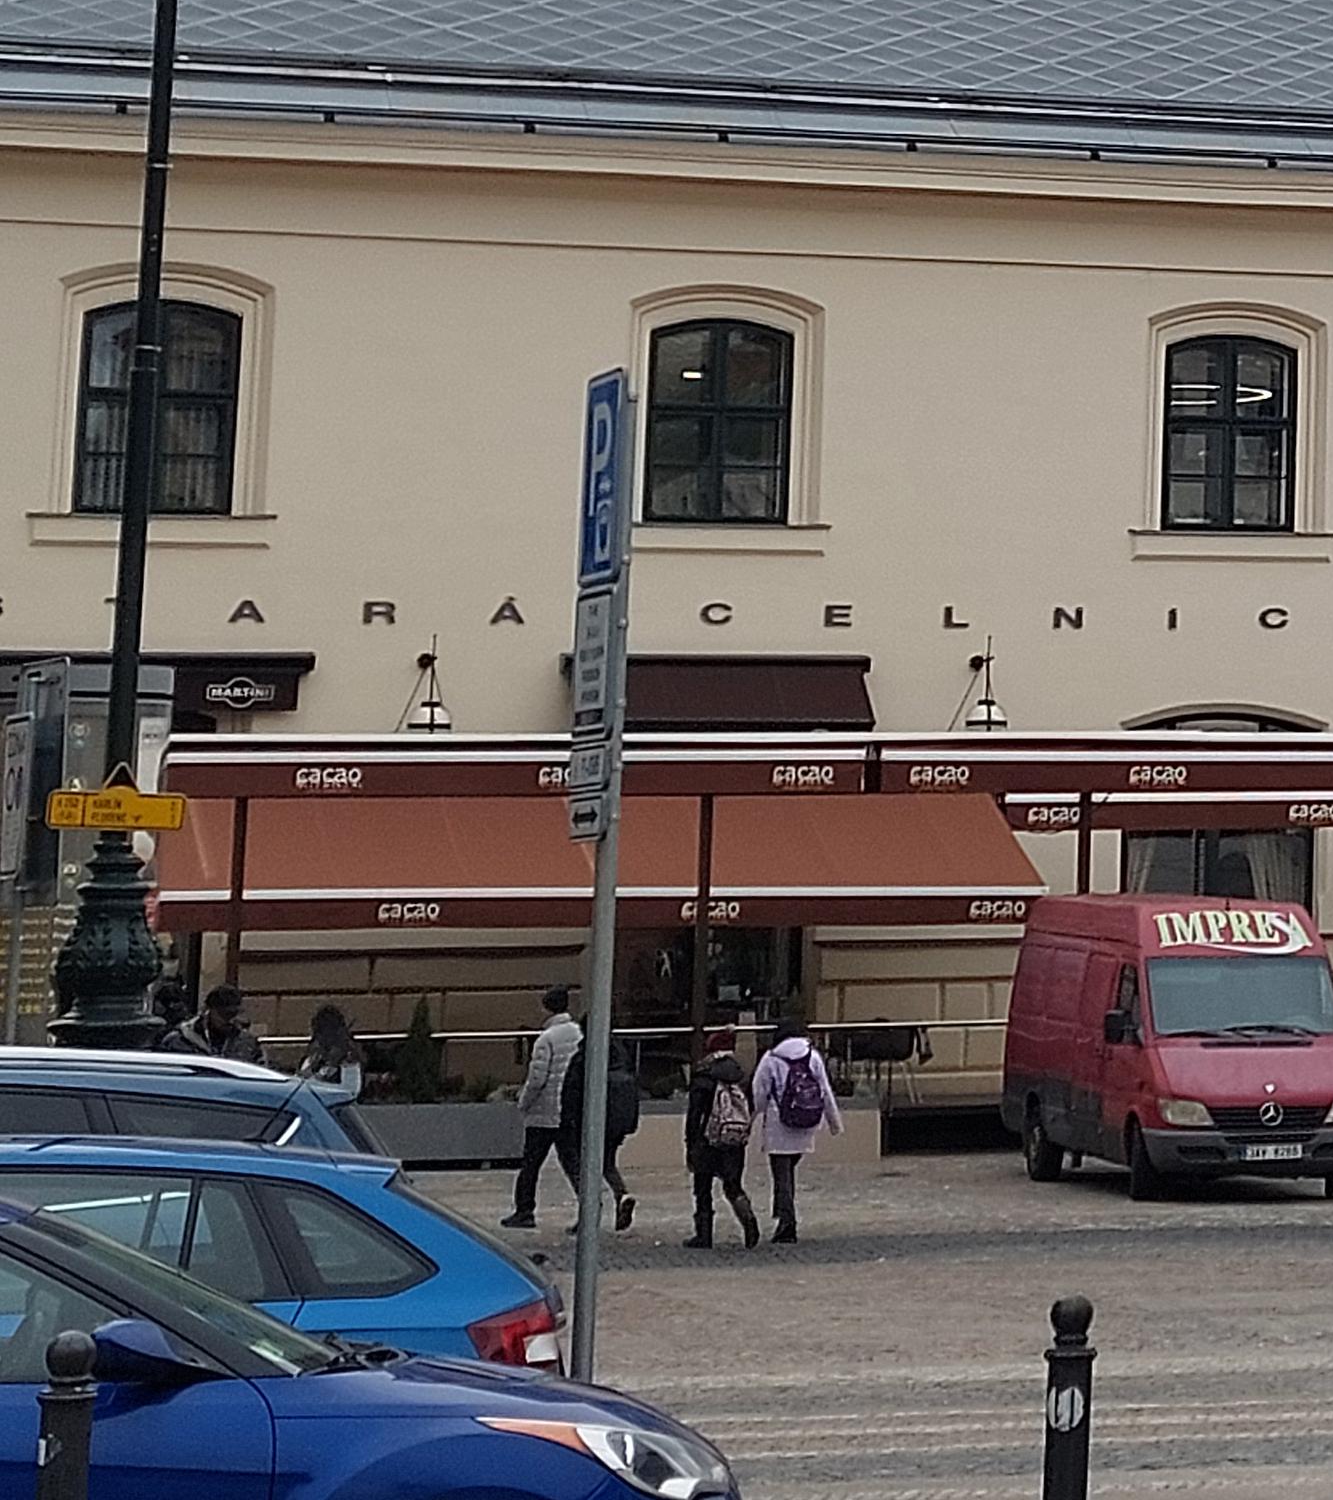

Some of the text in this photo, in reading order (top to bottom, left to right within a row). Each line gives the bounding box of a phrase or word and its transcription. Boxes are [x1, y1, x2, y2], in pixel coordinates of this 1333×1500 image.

[211, 687, 269, 697] MARTINI
[296, 767, 362, 784] cacao
[773, 765, 834, 782] cacao
[910, 765, 969, 782] cacao
[1129, 765, 1187, 781] cacao
[378, 902, 440, 919] cacao
[969, 900, 1025, 916] cacao
[1153, 911, 1312, 954] IMPRESA
